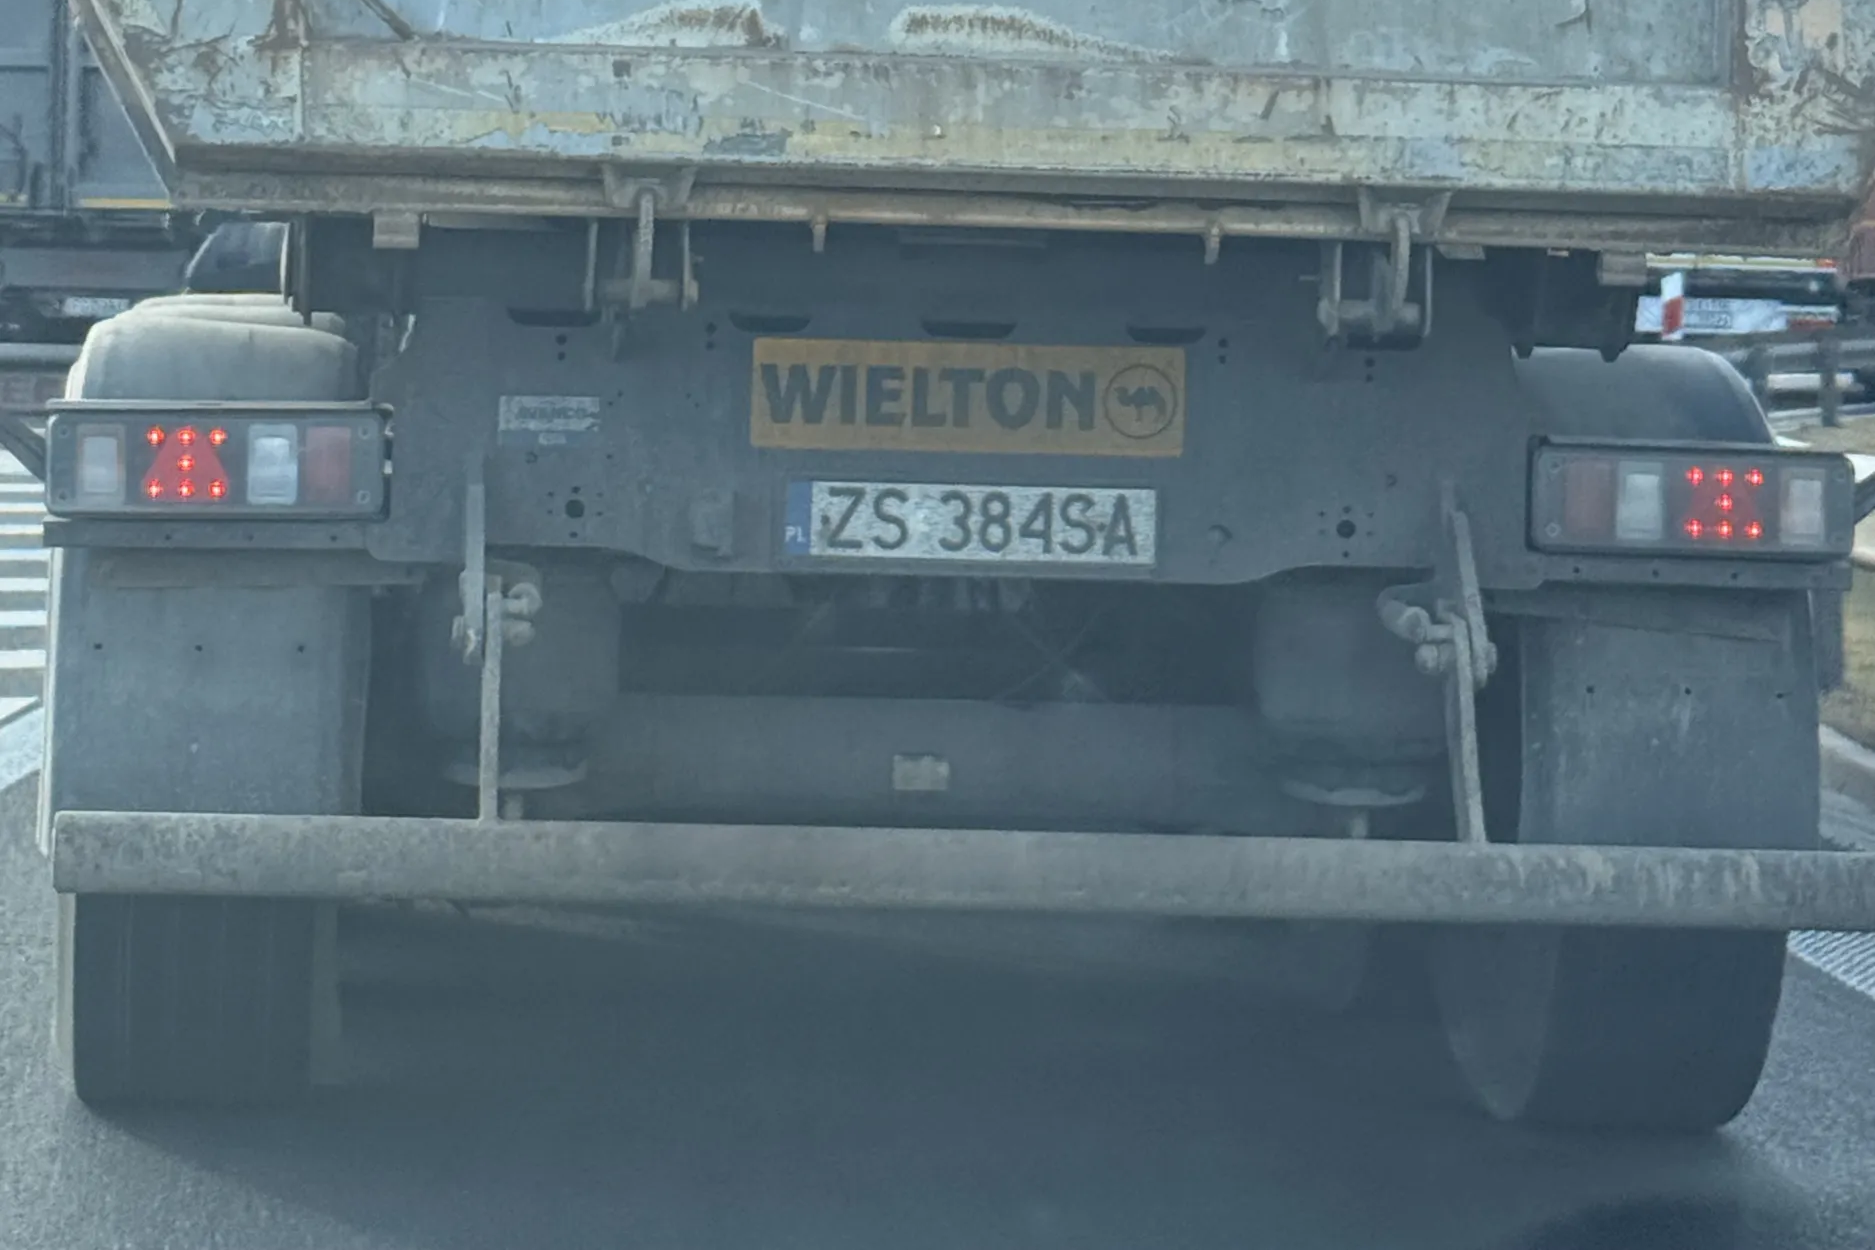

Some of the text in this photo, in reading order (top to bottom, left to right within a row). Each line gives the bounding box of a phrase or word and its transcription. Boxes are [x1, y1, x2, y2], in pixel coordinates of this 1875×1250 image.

[760, 362, 1097, 431] WIELTON
[784, 525, 807, 544] PL
[825, 486, 1139, 557] ZS 384SA
